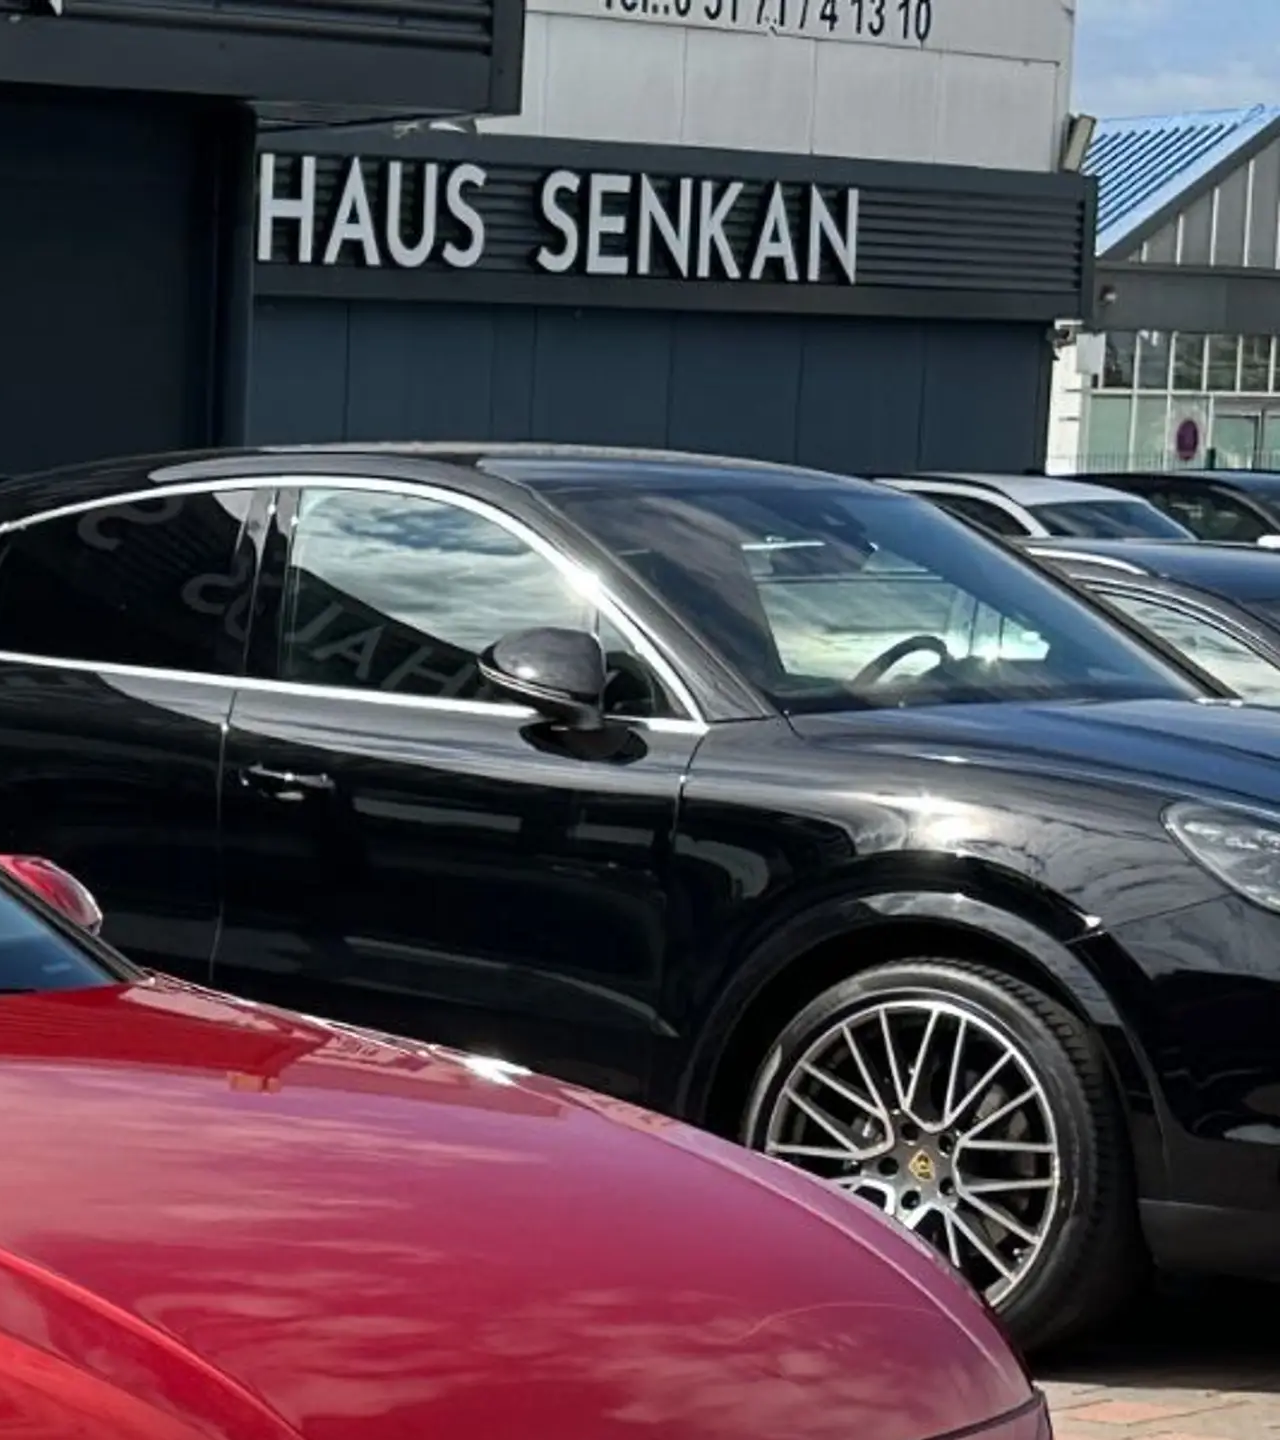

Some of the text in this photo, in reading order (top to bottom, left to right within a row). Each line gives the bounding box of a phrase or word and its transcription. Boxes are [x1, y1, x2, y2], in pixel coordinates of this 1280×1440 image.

[819, 0, 838, 32] 4
[850, 0, 886, 37] 13
[897, 0, 932, 42] 10
[256, 153, 861, 285] HAUS SENKAN
